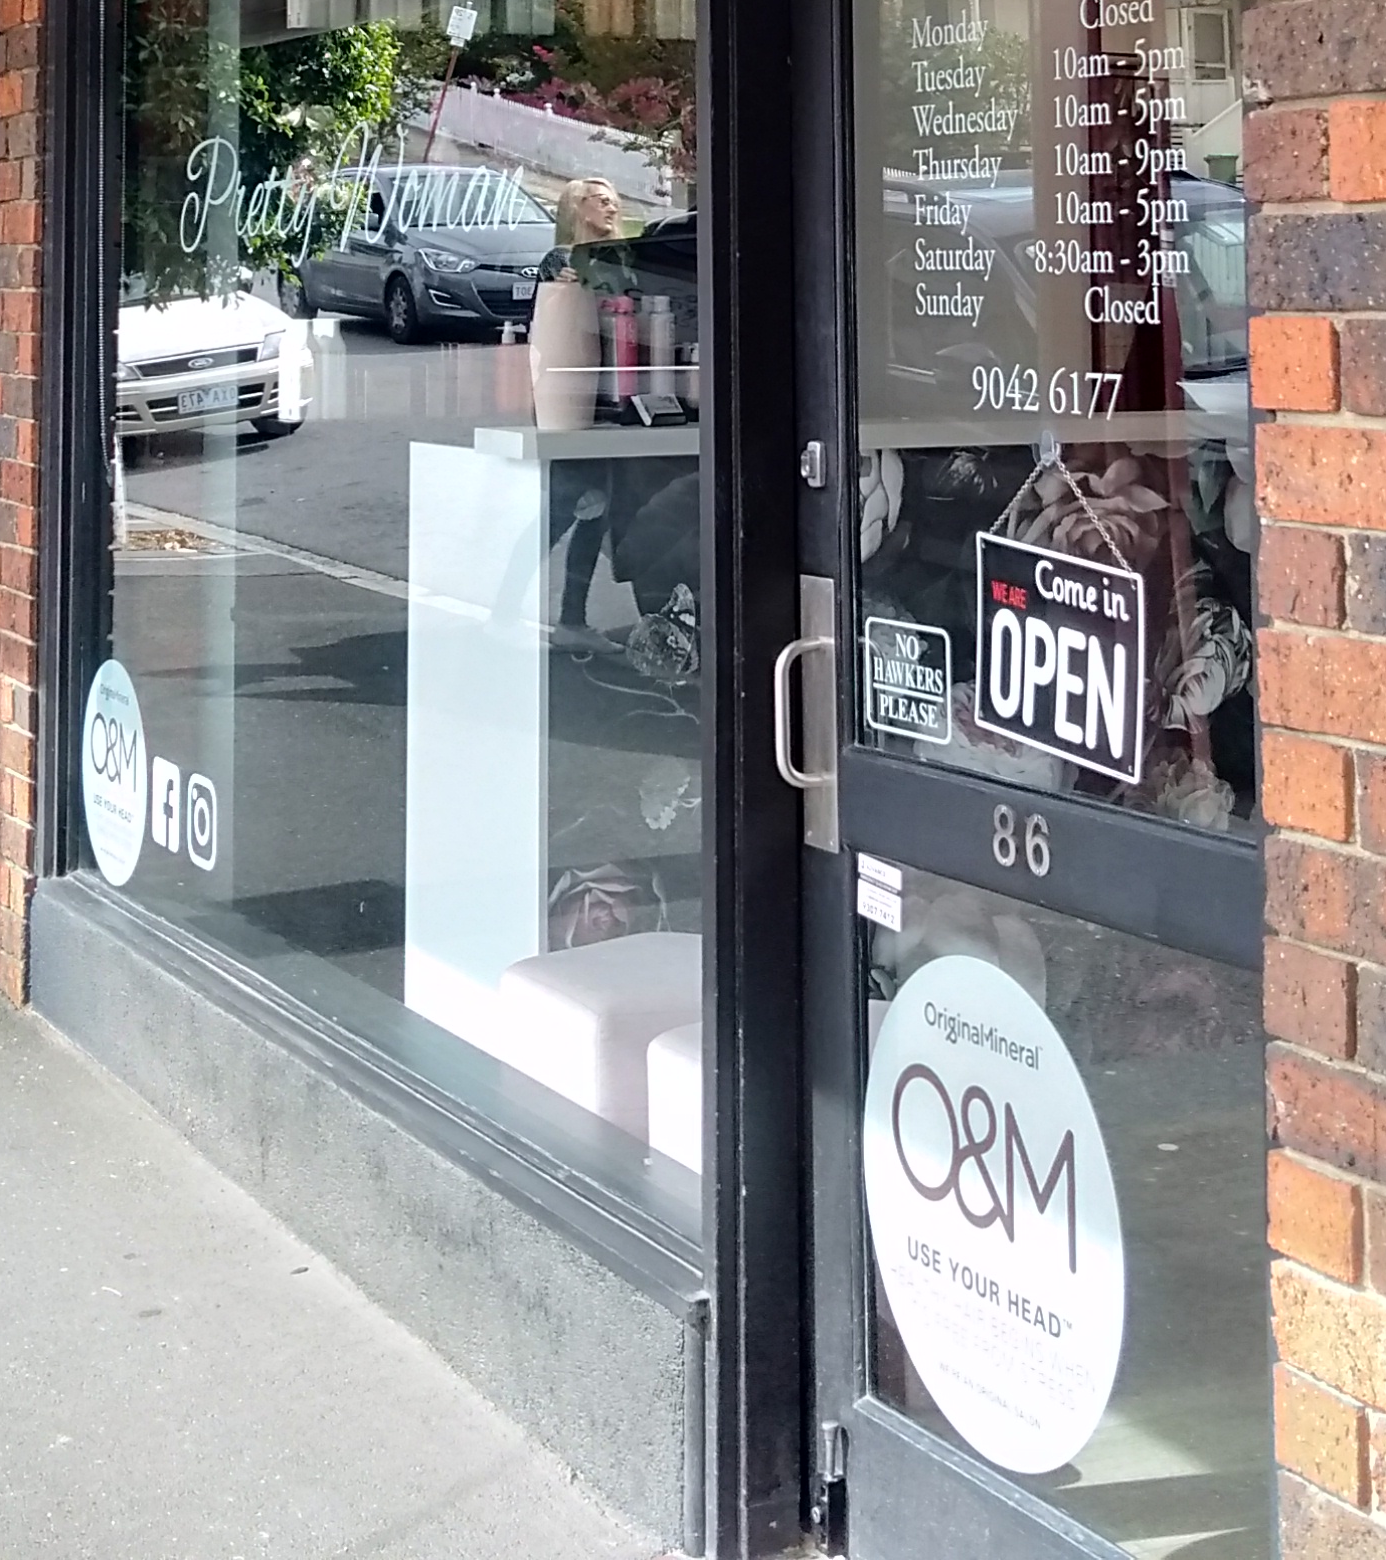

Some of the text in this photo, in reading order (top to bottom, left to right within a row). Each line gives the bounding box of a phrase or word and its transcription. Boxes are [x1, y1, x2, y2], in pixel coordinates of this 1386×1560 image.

[912, 11, 989, 51] Monday
[912, 57, 987, 100] Tuesday
[1052, 47, 1110, 82] 10am
[1134, 38, 1185, 88] 5pm
[912, 98, 1018, 141] Wednesday
[1053, 94, 1110, 129] 10am
[1134, 89, 1186, 136] 5pm
[914, 144, 1002, 187] Thursday
[1054, 144, 1111, 177] 10am
[1135, 139, 1188, 184] 9pm
[180, 121, 527, 268] Pretty Woman
[914, 193, 972, 235] Friday
[1055, 191, 1112, 224] 10am
[1136, 191, 1189, 235] 5pm
[915, 238, 996, 281] Saturday
[1034, 239, 1114, 275] 8:30am
[1137, 239, 1190, 285] 3pm
[915, 283, 1160, 326] Sunday Closed
[972, 364, 1122, 422] 9042 6177
[991, 580, 1026, 609] WE ARE
[1035, 560, 1130, 622] Come in
[895, 633, 919, 662] NO
[873, 656, 943, 696] HAWKERS
[990, 608, 1125, 759] OPEN
[880, 696, 938, 729] PLEASE
[90, 712, 138, 793] O&M
[993, 804, 1050, 877] 86
[892, 1063, 1076, 1274] O&M
[907, 1235, 941, 1274] USE
[948, 1257, 1001, 1307] YOUR
